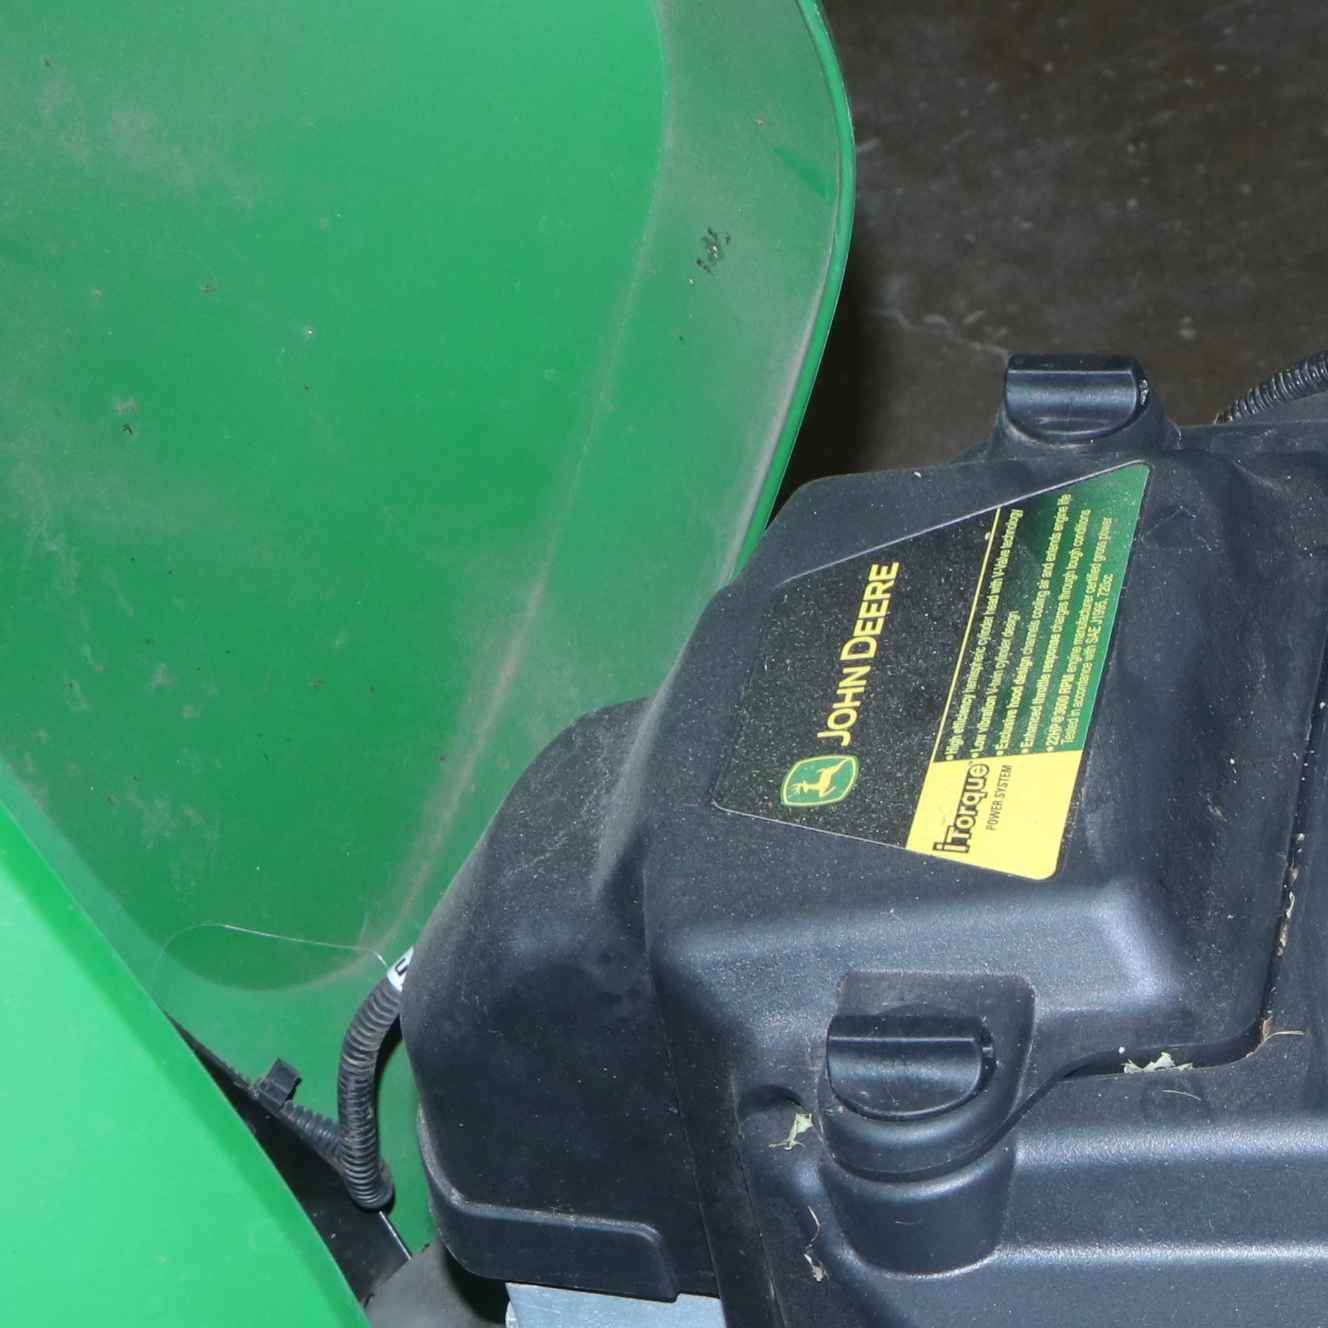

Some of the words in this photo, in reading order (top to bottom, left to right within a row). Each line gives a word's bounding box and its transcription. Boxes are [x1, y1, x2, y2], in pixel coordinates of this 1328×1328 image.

[1056, 493, 1071, 505] life
[1053, 505, 1068, 531] engine
[1045, 531, 1061, 561] extends
[1041, 562, 1054, 577] and
[988, 577, 1002, 594] with
[1036, 578, 1049, 589] air
[839, 562, 899, 662] DEERE
[982, 594, 999, 615] head
[1031, 590, 1050, 618] cooling
[1001, 610, 1020, 637] design
[1020, 619, 1040, 654] channels
[994, 638, 1011, 669] cylinder
[985, 669, 1003, 694] V-twin
[1013, 656, 1032, 684] design
[817, 665, 872, 747] JOHN
[1006, 685, 1023, 708] hood
[976, 695, 996, 732] vibration
[969, 733, 986, 751] Low
[994, 709, 1017, 749] Exclusive
[944, 734, 963, 754] High
[985, 800, 1002, 830] POWER
[994, 764, 1011, 797] SYSTEM
